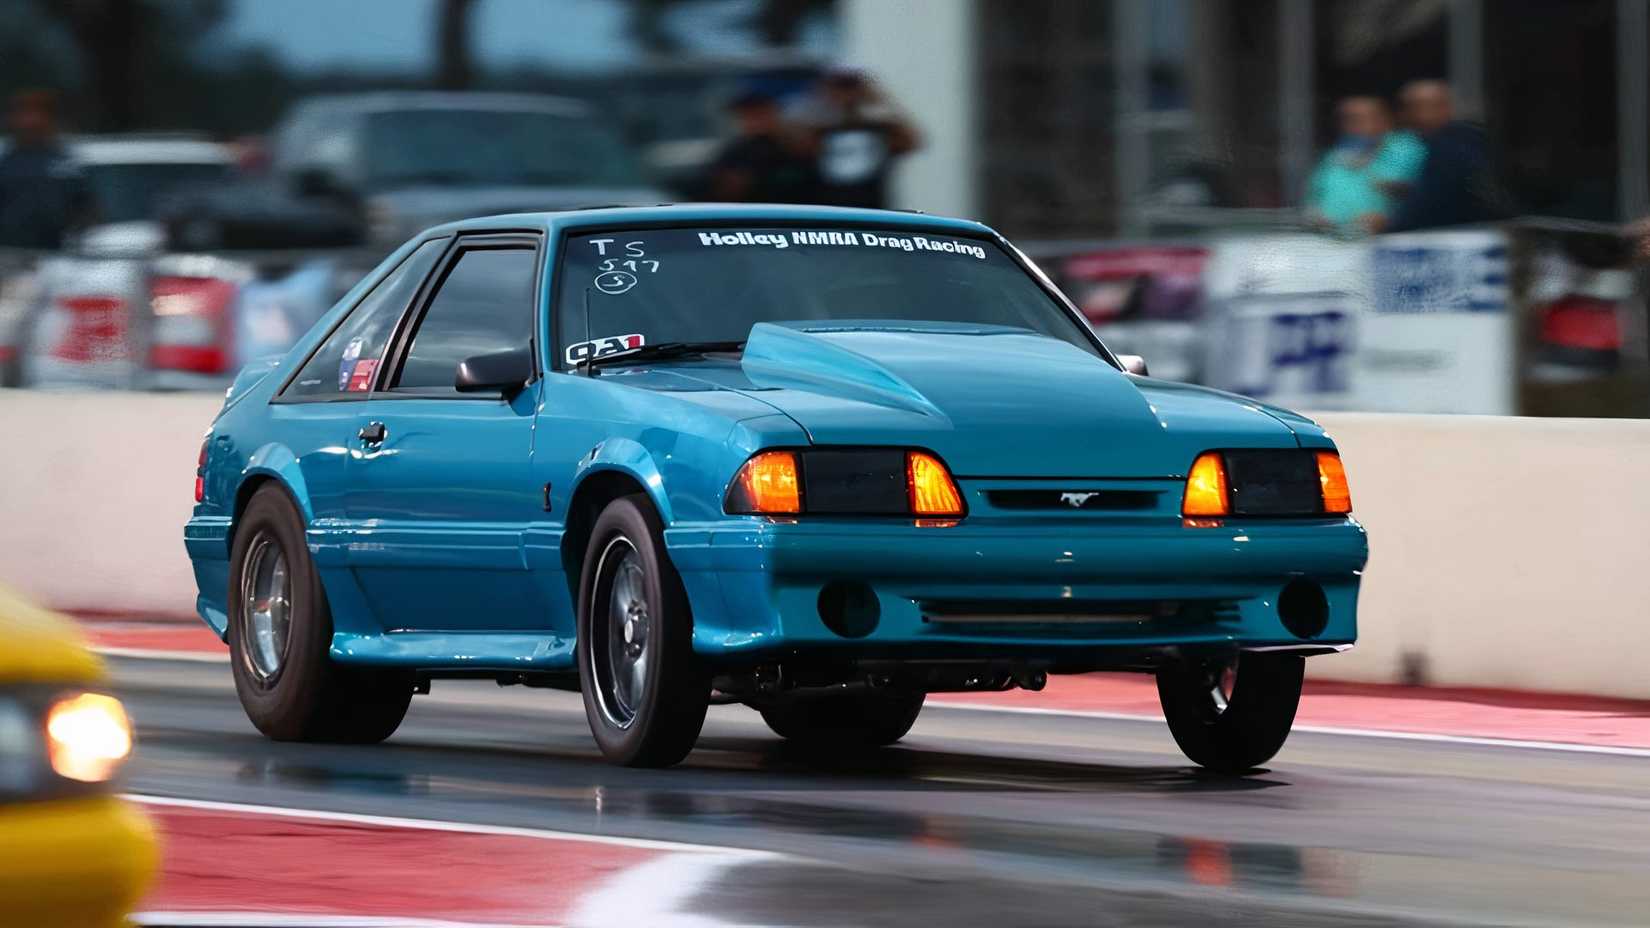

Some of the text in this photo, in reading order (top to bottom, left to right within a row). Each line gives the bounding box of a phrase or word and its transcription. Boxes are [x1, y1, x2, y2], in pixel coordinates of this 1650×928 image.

[589, 238, 645, 257] T S
[698, 231, 986, 259] Holley NMRA Drag Racing
[569, 334, 642, 362] QA1
